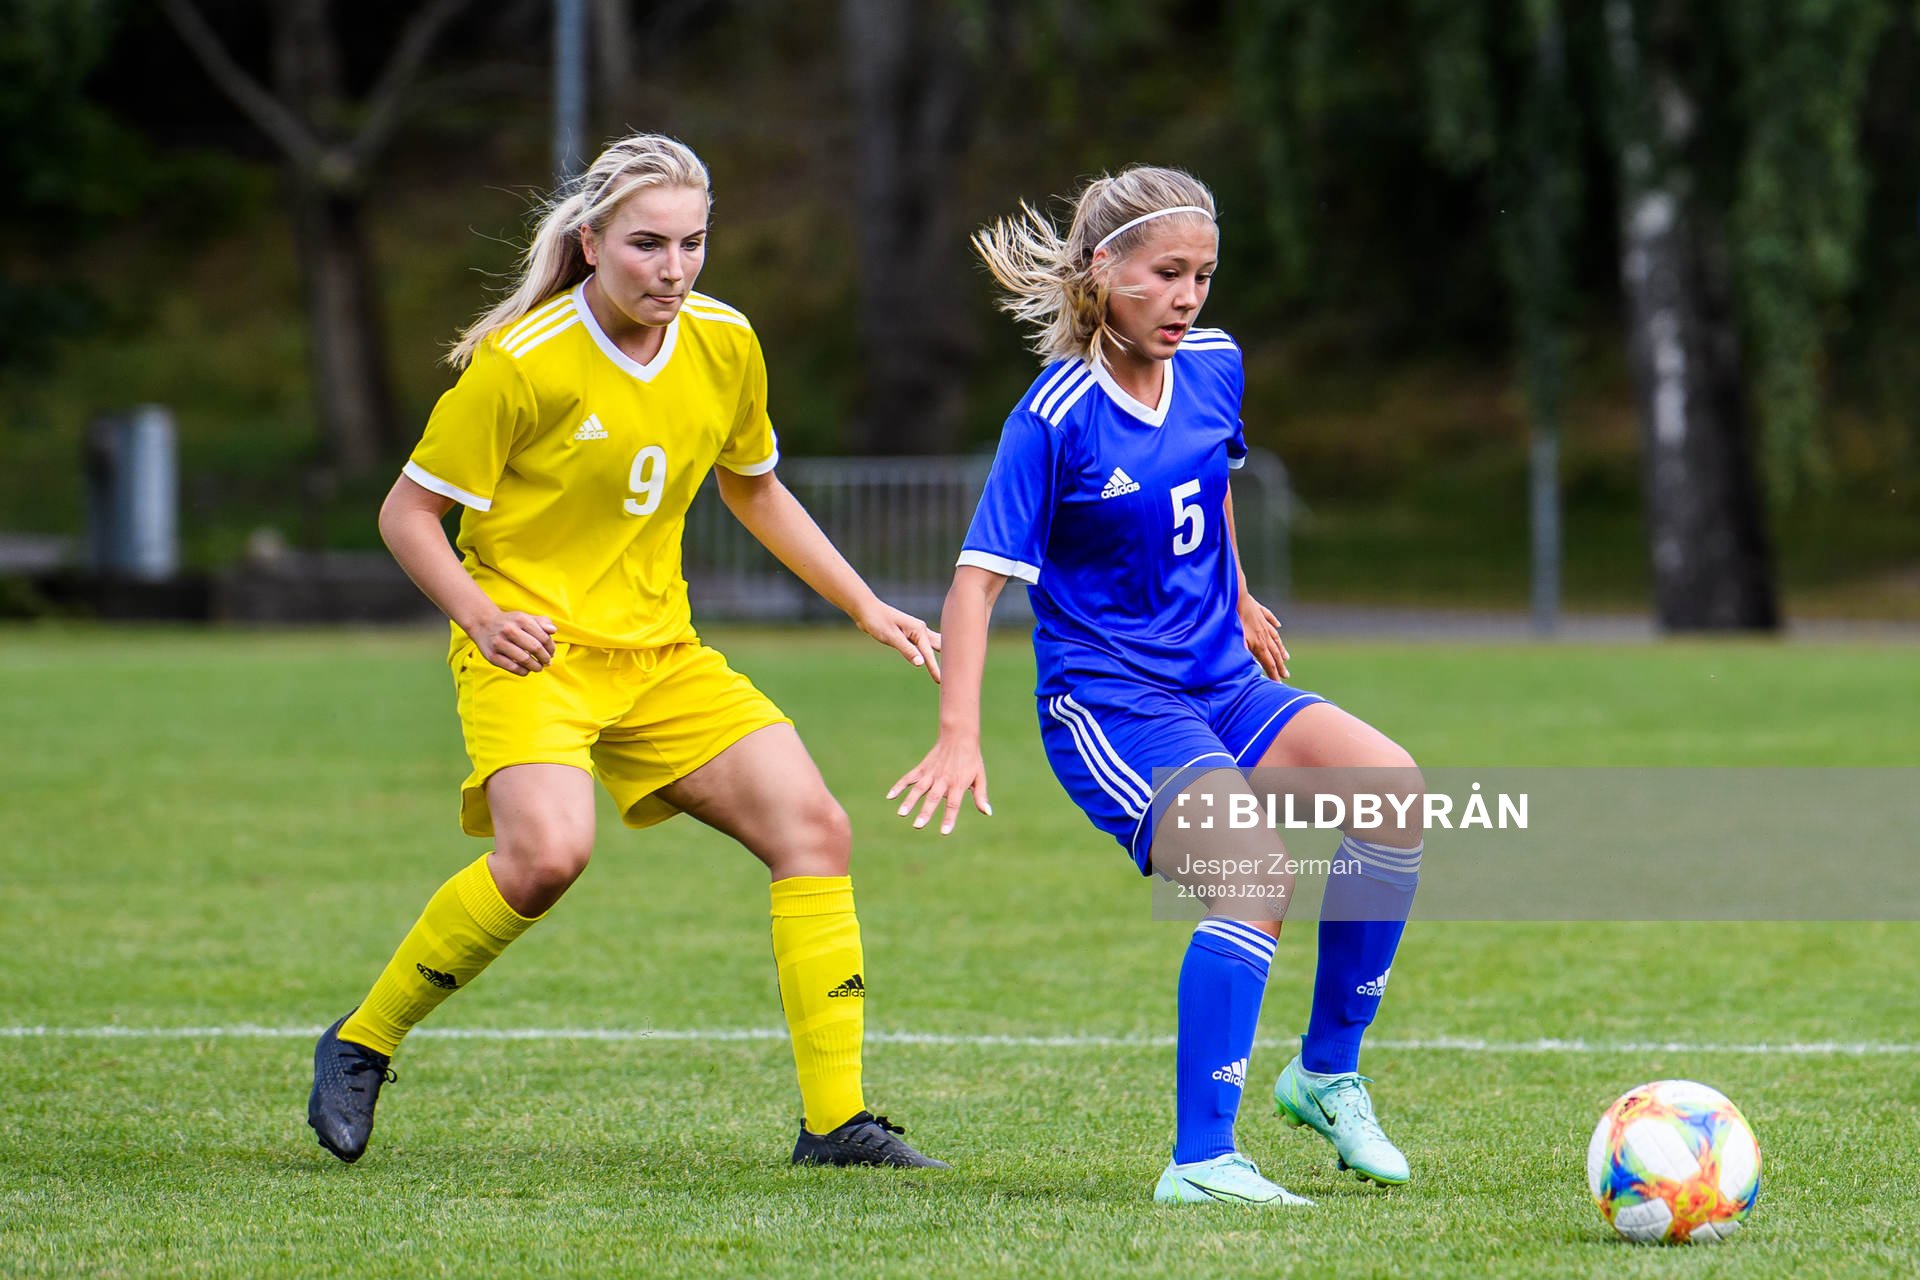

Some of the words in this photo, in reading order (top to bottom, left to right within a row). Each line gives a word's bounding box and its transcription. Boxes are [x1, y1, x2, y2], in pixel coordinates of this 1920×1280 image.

[574, 430, 609, 441] adidas
[623, 445, 667, 517] 9
[1101, 482, 1141, 499] adidas
[1170, 478, 1205, 556] 5
[416, 963, 460, 990] adida
[828, 988, 865, 998] adida
[1211, 1070, 1245, 1089] adida
